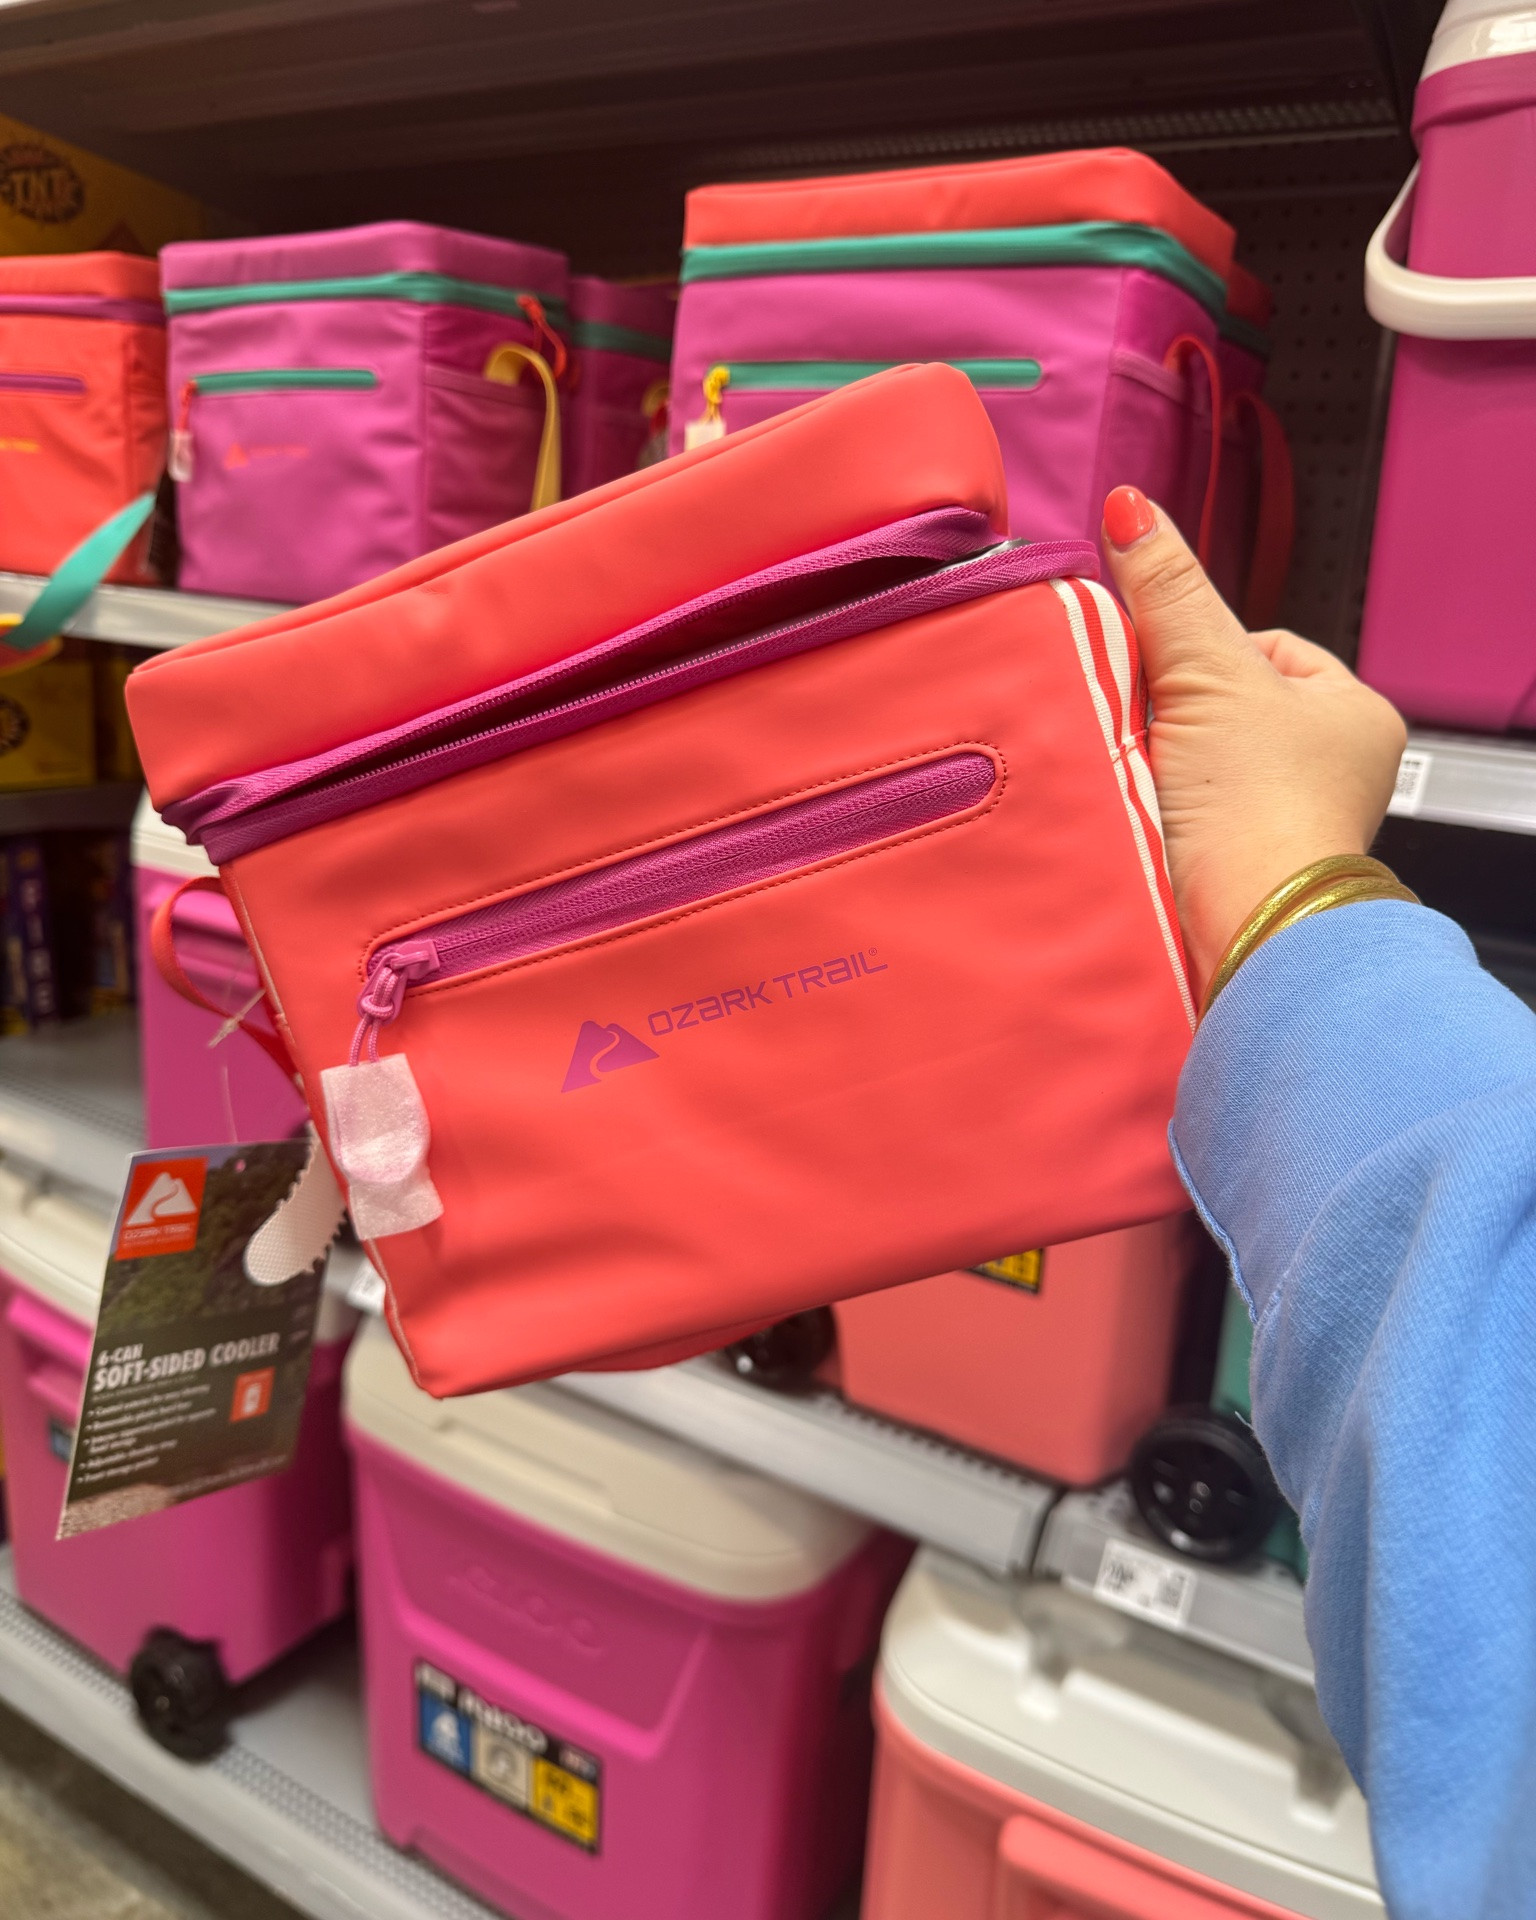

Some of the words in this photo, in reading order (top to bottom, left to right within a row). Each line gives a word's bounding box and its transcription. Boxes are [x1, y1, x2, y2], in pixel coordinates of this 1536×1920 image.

[647, 981, 774, 1037] OZARK
[93, 1347, 206, 1393] SOFT-SIDED
[208, 1332, 281, 1368] COOLER
[97, 1343, 144, 1367] 6-CAN
